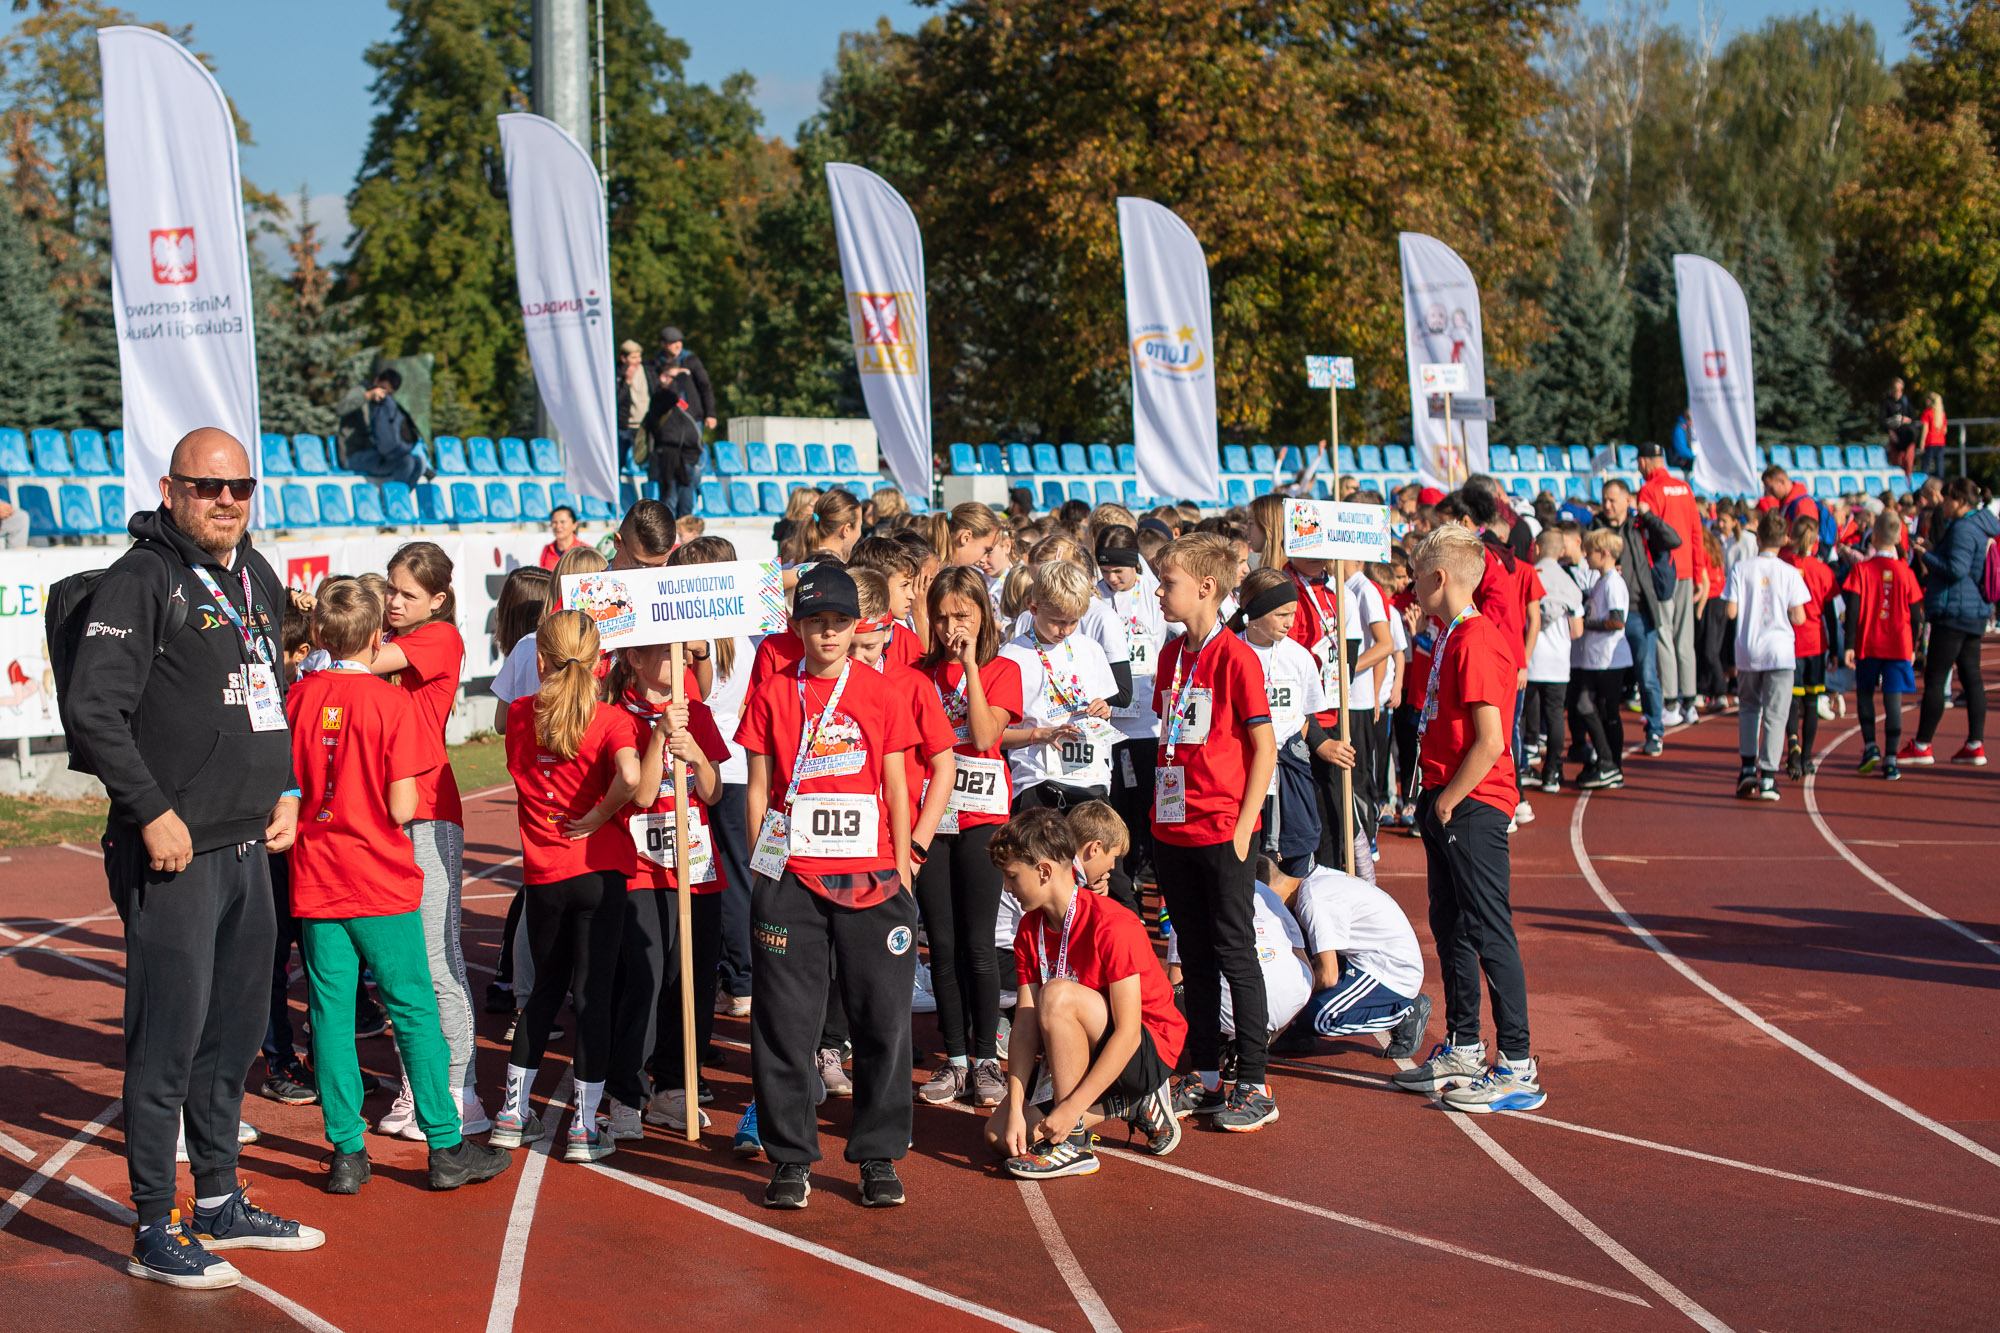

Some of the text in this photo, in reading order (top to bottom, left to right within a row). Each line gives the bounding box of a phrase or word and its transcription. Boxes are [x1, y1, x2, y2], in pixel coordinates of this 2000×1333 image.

[658, 575, 735, 595] WOJEWÓDZTWO
[652, 596, 745, 622] DOLNOŚLĄSKIE
[803, 751, 866, 767] EKKOATLETYCZNE
[1062, 741, 1094, 764] 019
[802, 763, 827, 774] ADZIEJE
[953, 768, 996, 796] 027
[812, 808, 861, 836] 013
